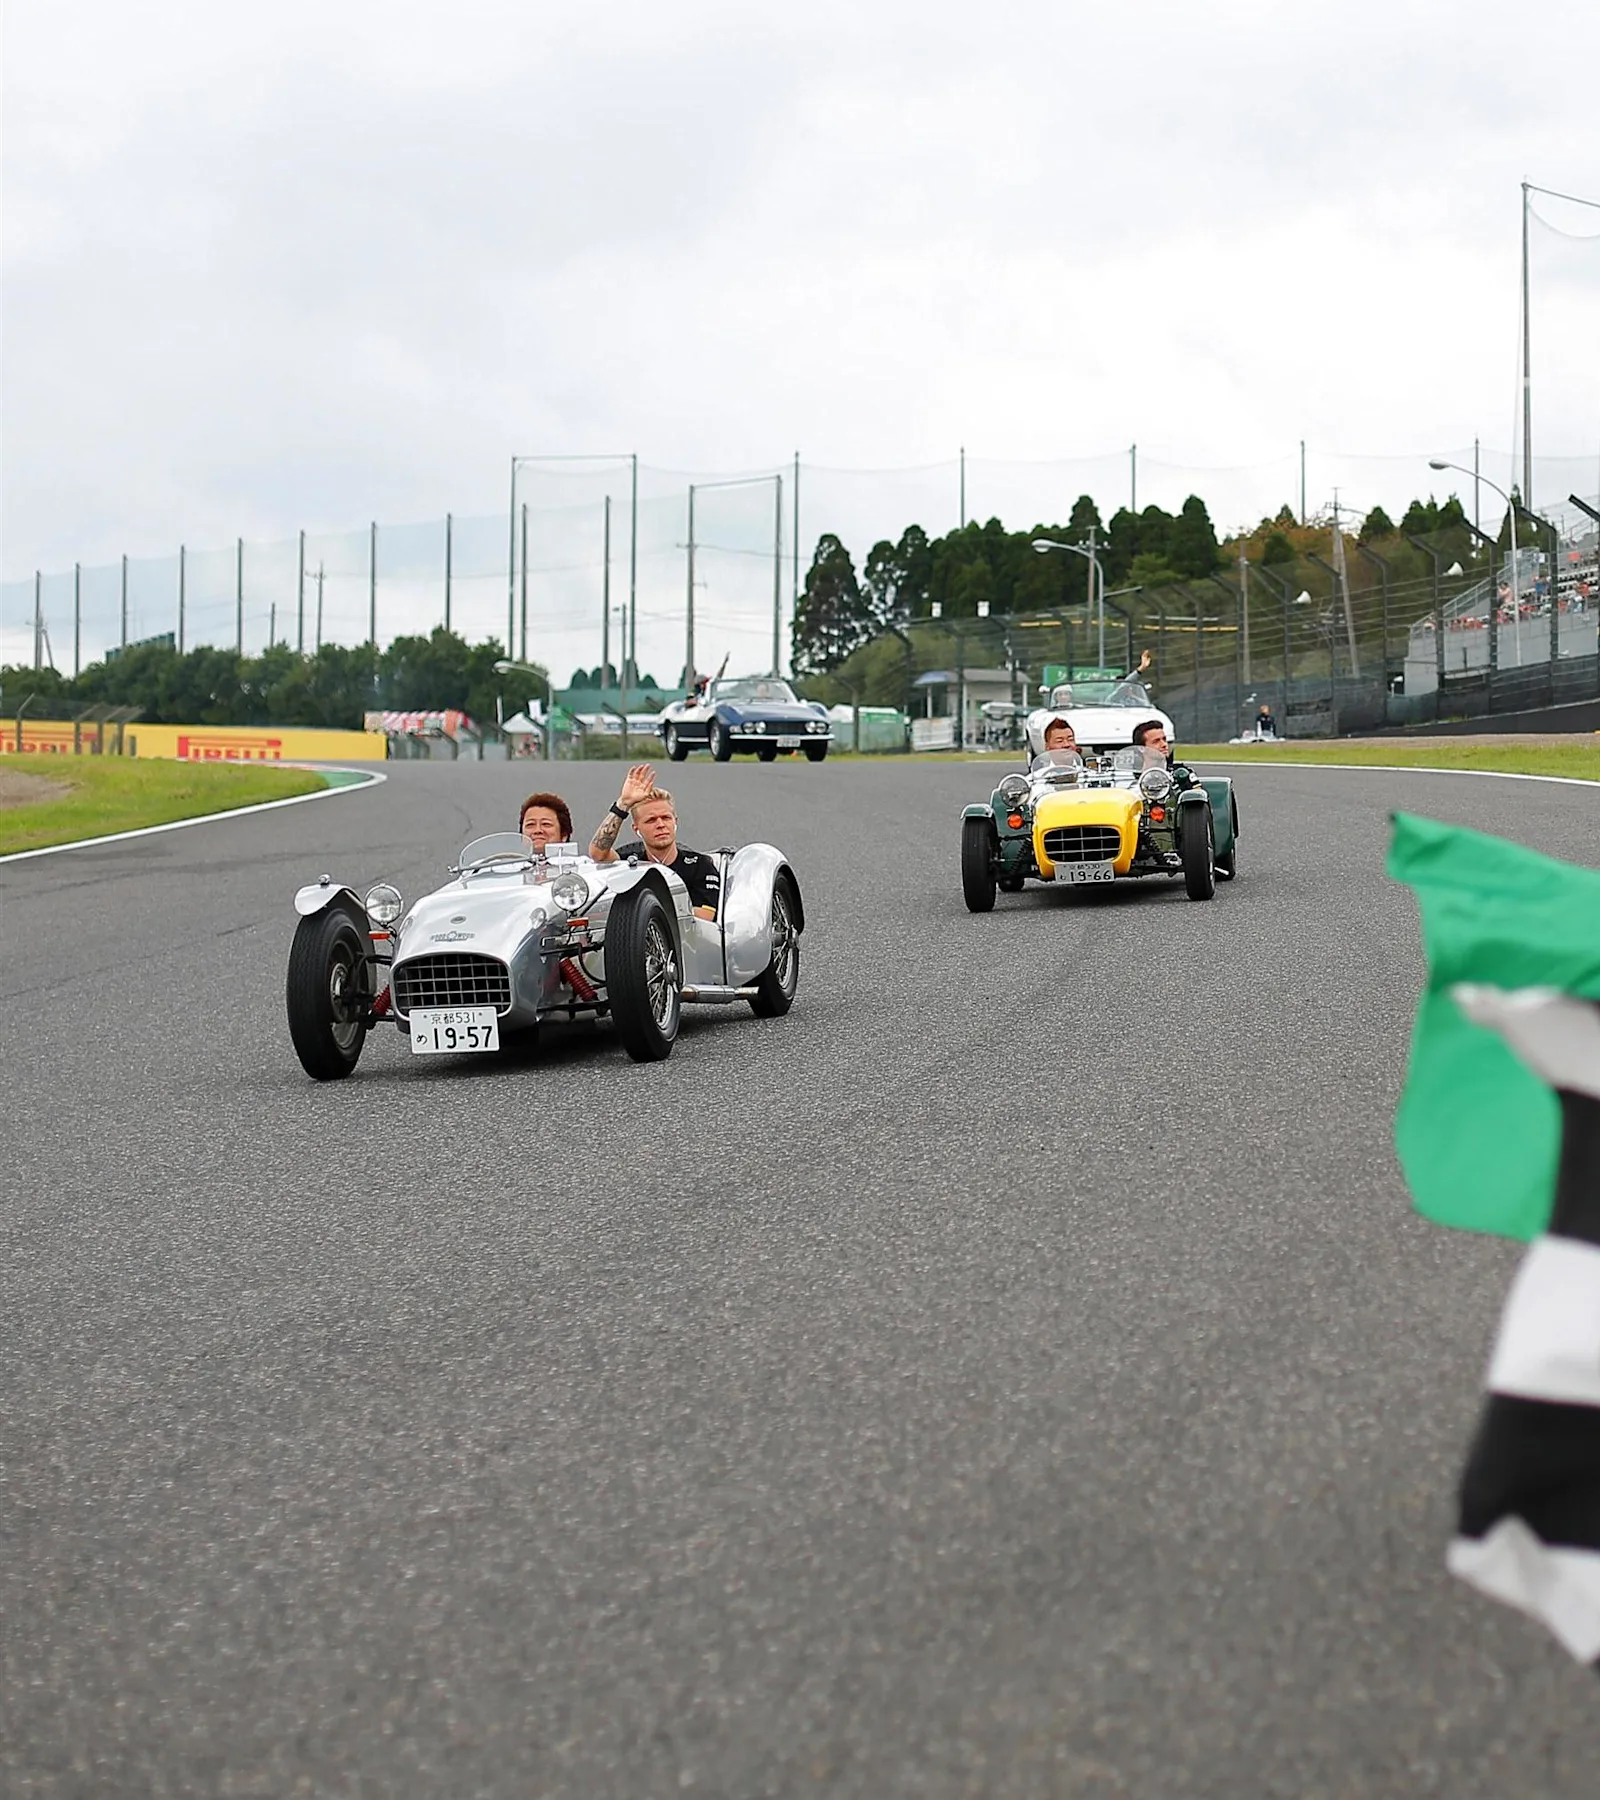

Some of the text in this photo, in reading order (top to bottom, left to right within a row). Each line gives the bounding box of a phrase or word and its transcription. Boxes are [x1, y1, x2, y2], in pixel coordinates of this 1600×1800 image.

[178, 736, 282, 760] PIRELLI
[1070, 870, 1111, 881] 19-66
[430, 1012, 476, 1025] 京都531
[416, 1026, 492, 1050] め 19-57
